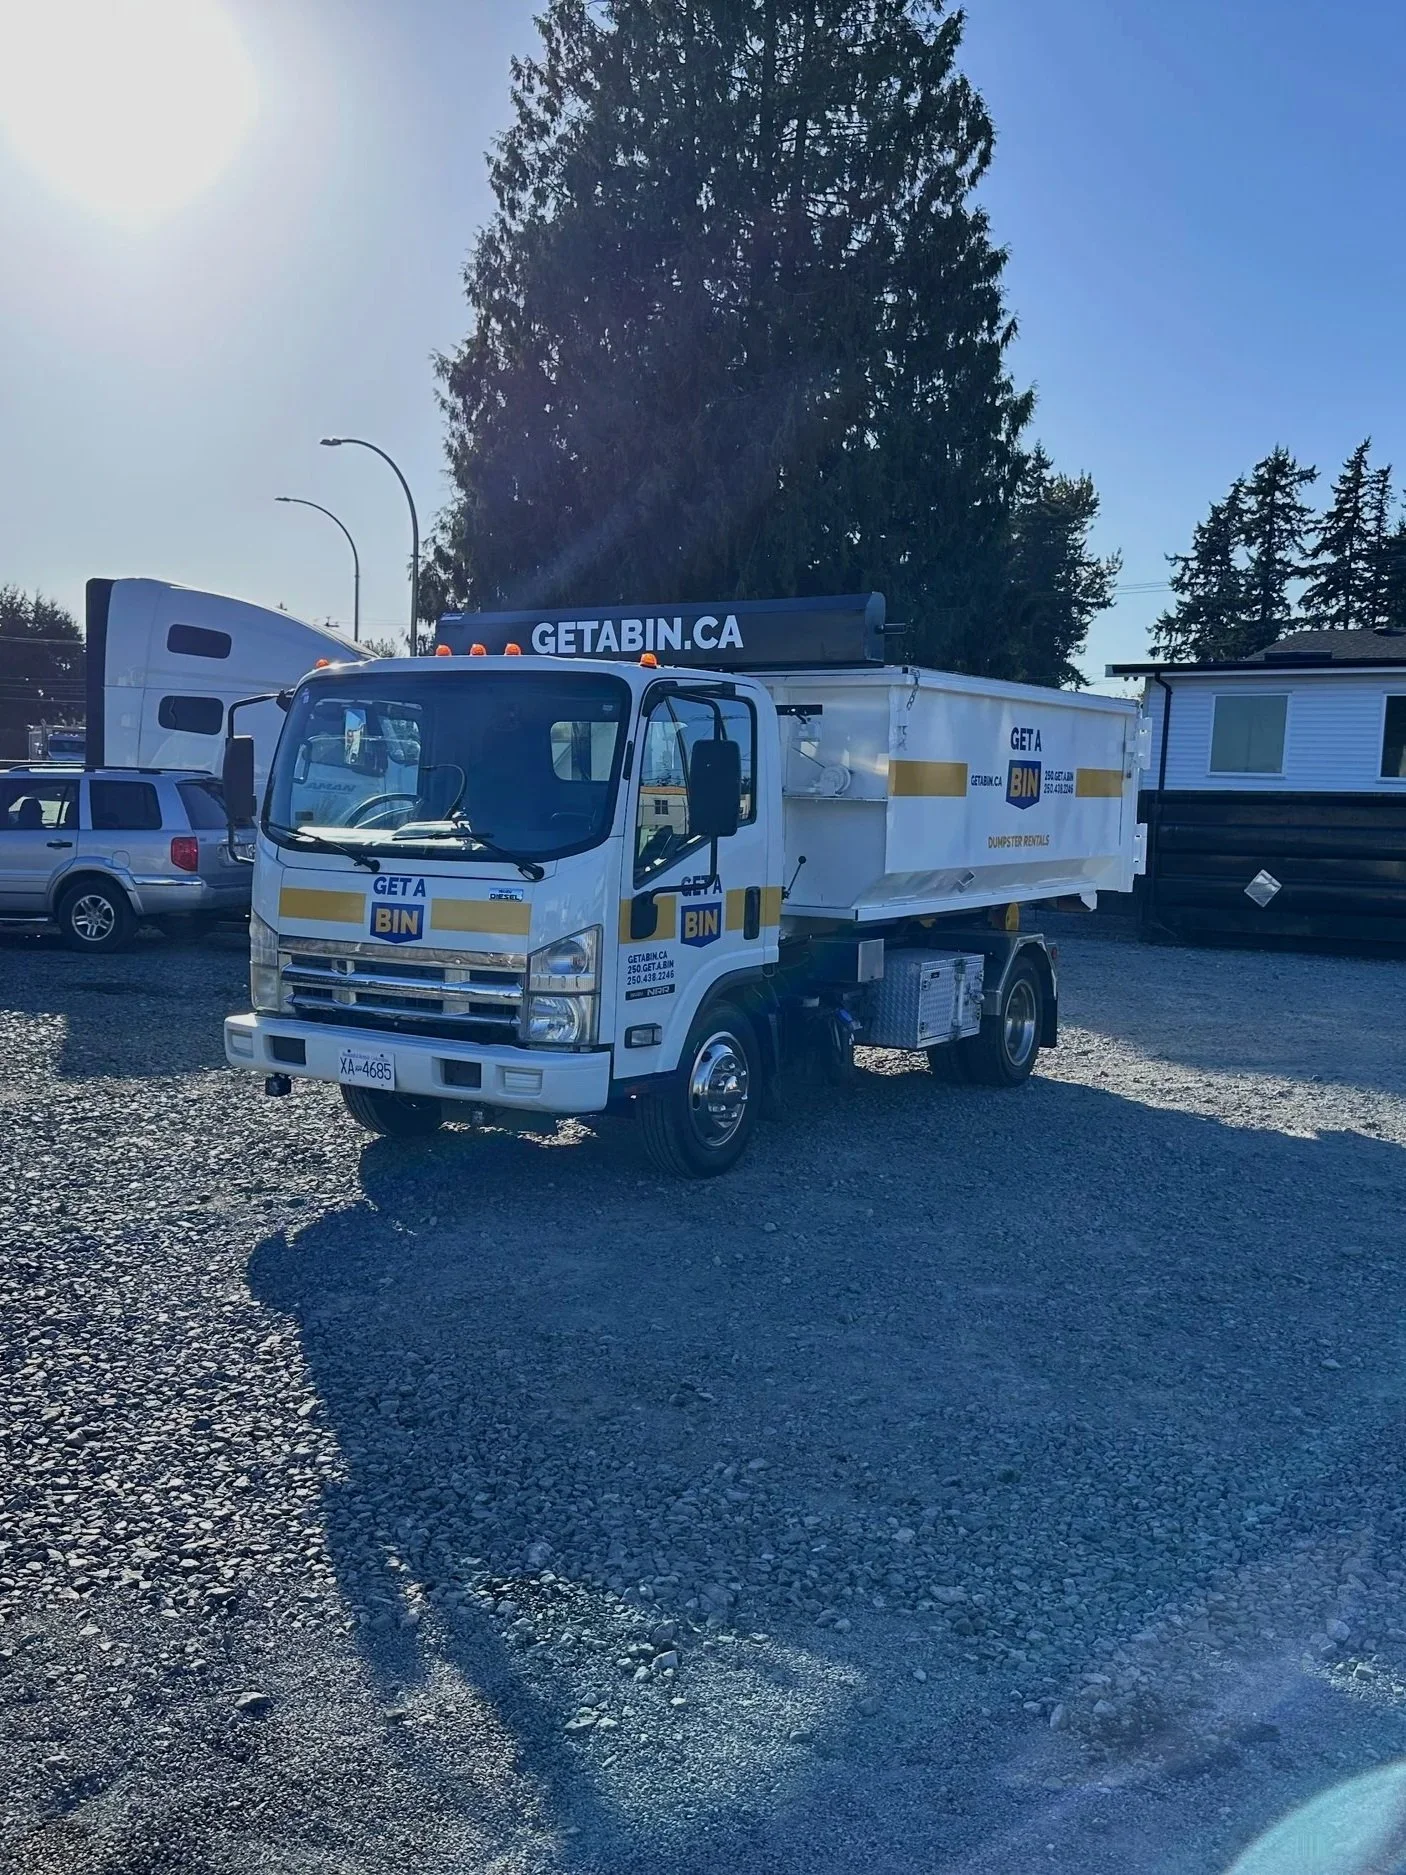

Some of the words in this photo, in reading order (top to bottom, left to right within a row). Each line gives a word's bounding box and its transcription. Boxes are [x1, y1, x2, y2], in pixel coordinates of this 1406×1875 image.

[531, 614, 744, 654] GETABIN.CA
[1010, 727, 1034, 751] GET
[1034, 729, 1042, 752] A
[970, 775, 1003, 787] GETABIN.CA
[1009, 767, 1039, 798] BIN
[988, 835, 1022, 849] DUMPSTER
[1023, 834, 1050, 847] RENTALS
[373, 876, 412, 896] GET
[412, 878, 427, 897] A
[712, 873, 723, 895] A
[489, 893, 521, 902] DIESEL
[375, 907, 419, 936] BIN
[684, 909, 718, 939] BIN
[627, 950, 668, 964] GETABIN.CA
[627, 960, 675, 975] 250.GET.A.BIN
[626, 969, 675, 986] 250.438.2246
[646, 985, 670, 996] NRR
